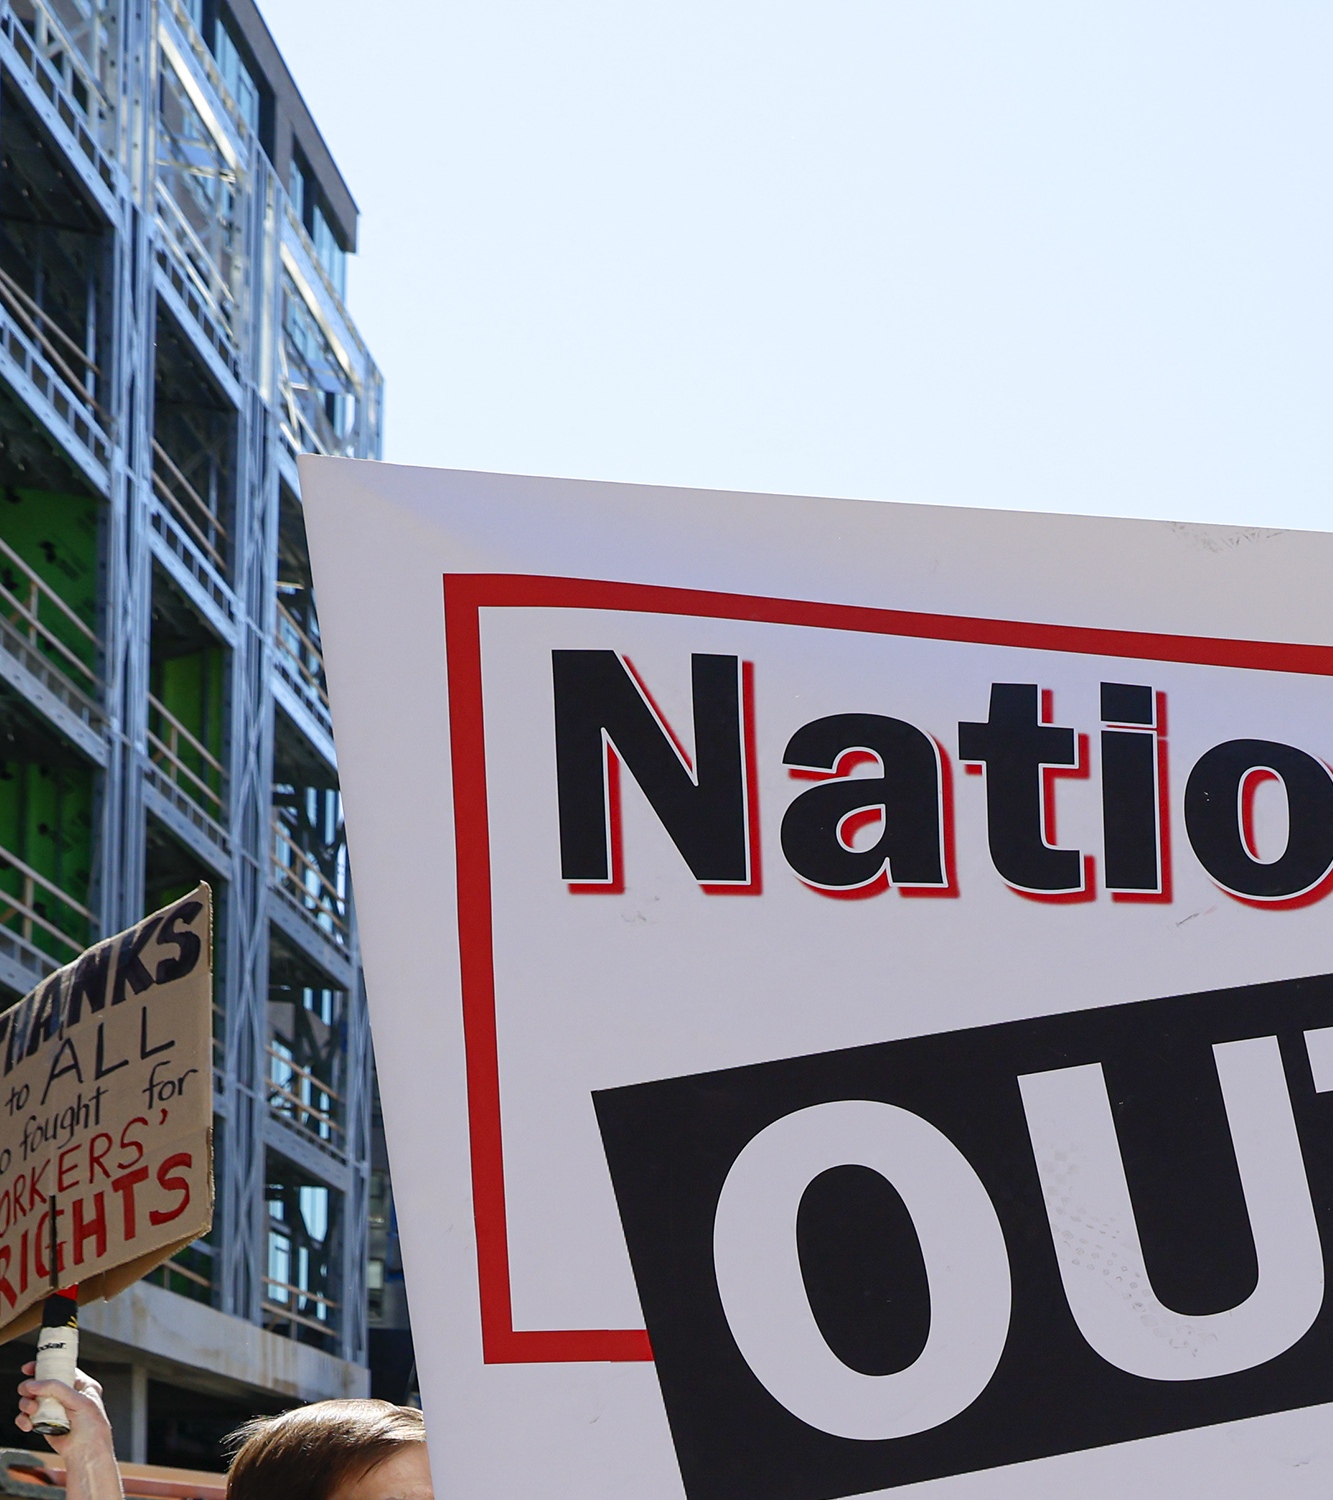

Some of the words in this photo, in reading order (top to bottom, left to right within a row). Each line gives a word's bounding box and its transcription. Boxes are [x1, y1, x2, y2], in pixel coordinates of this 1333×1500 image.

[0, 901, 203, 1078] HANKS
[6, 1083, 31, 1117] to
[40, 1005, 176, 1106] ALL
[19, 1085, 110, 1162] fought
[142, 1060, 199, 1111] for
